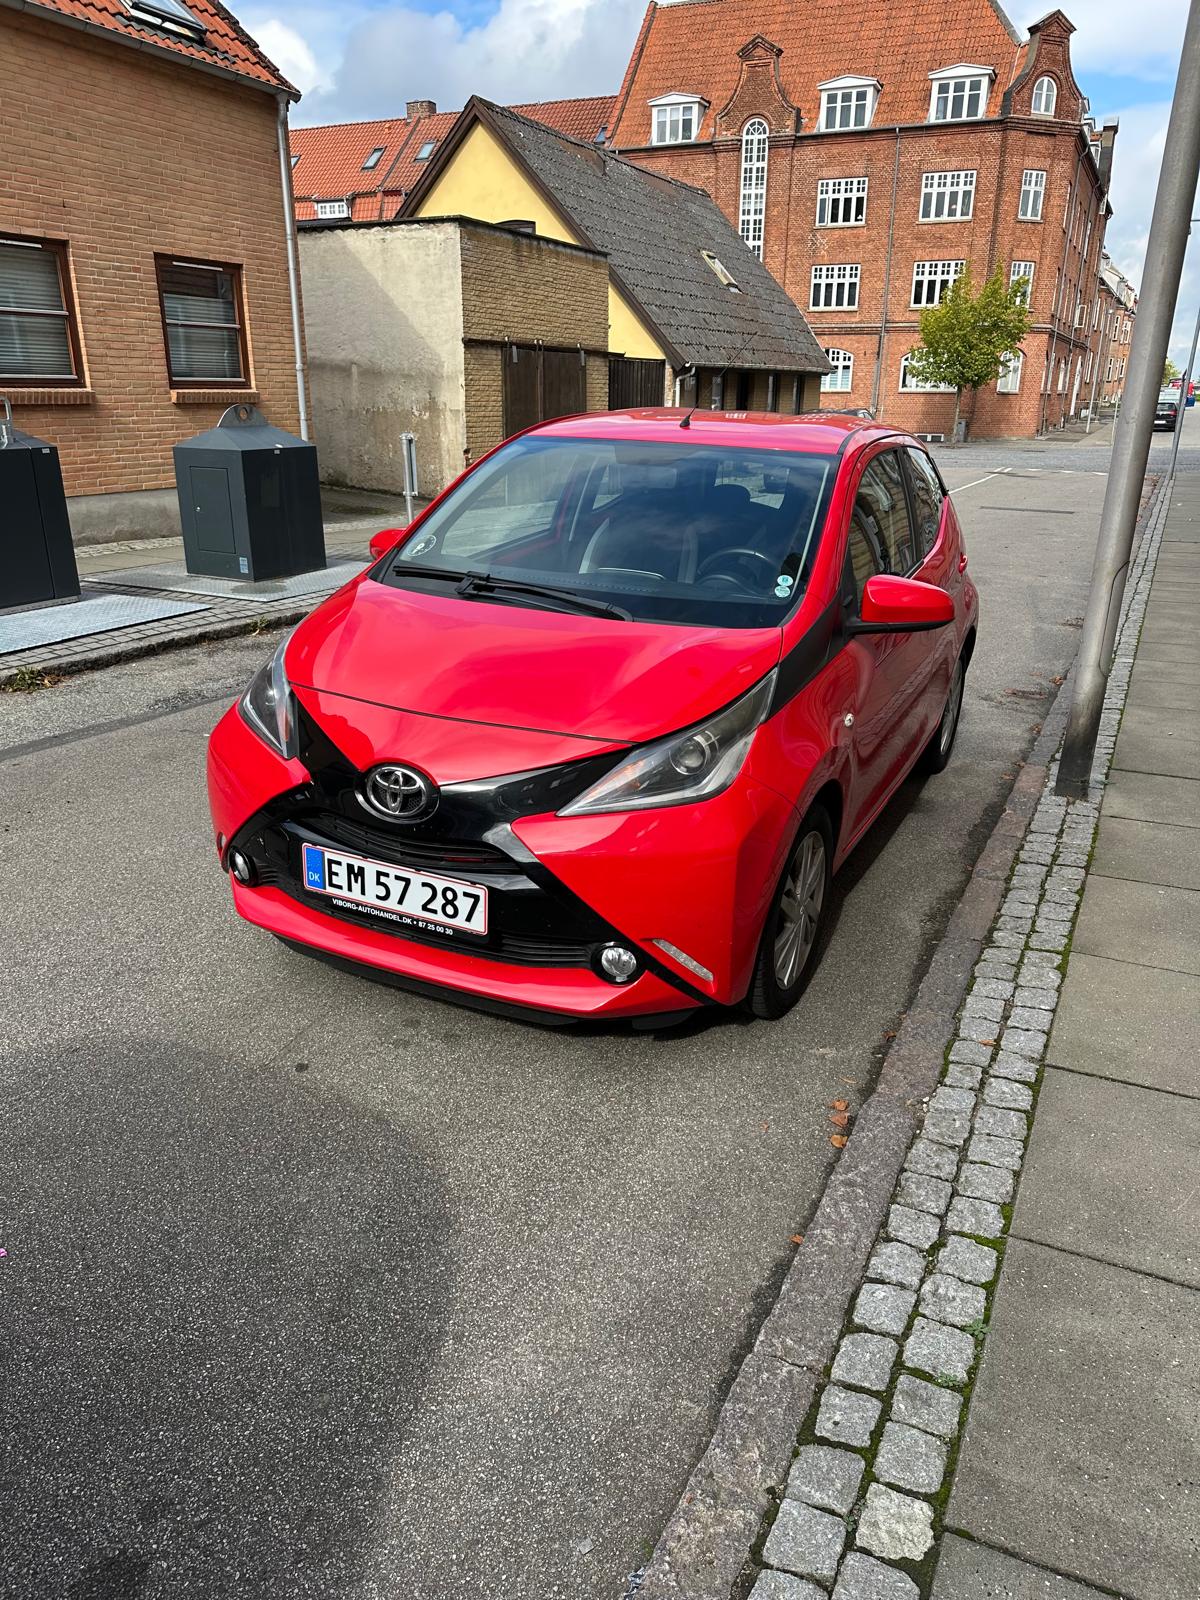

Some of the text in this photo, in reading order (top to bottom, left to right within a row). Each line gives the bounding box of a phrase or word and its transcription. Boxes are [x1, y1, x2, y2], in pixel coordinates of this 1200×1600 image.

[309, 872, 320, 882] DK
[328, 859, 480, 922] EM 57 287
[332, 898, 412, 924] VIBORG-AUTOHANDEL.DK
